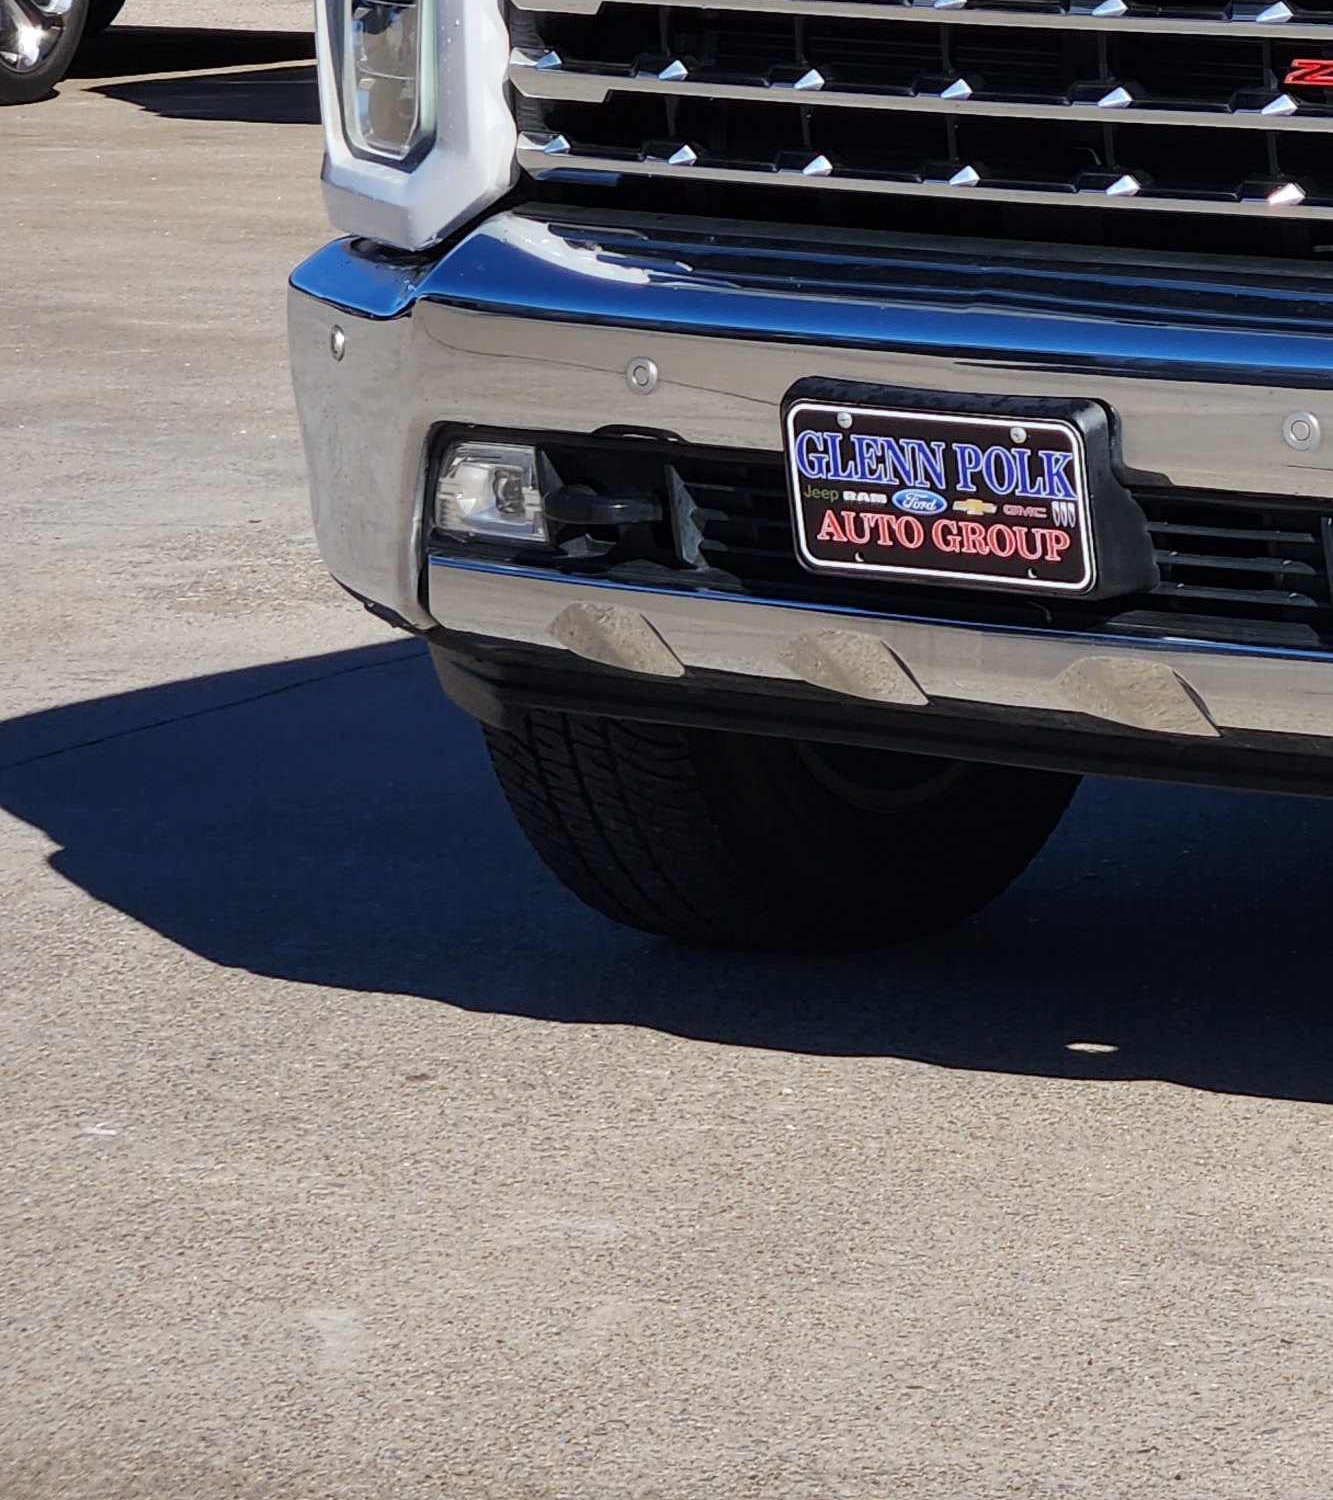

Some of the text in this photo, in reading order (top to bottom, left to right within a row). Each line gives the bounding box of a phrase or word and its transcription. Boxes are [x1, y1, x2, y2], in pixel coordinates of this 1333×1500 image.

[795, 429, 1078, 501] GLENN POLK
[803, 484, 1048, 519] Jeep RAM Ford GMC
[817, 509, 1071, 562] AUTO GROUP
